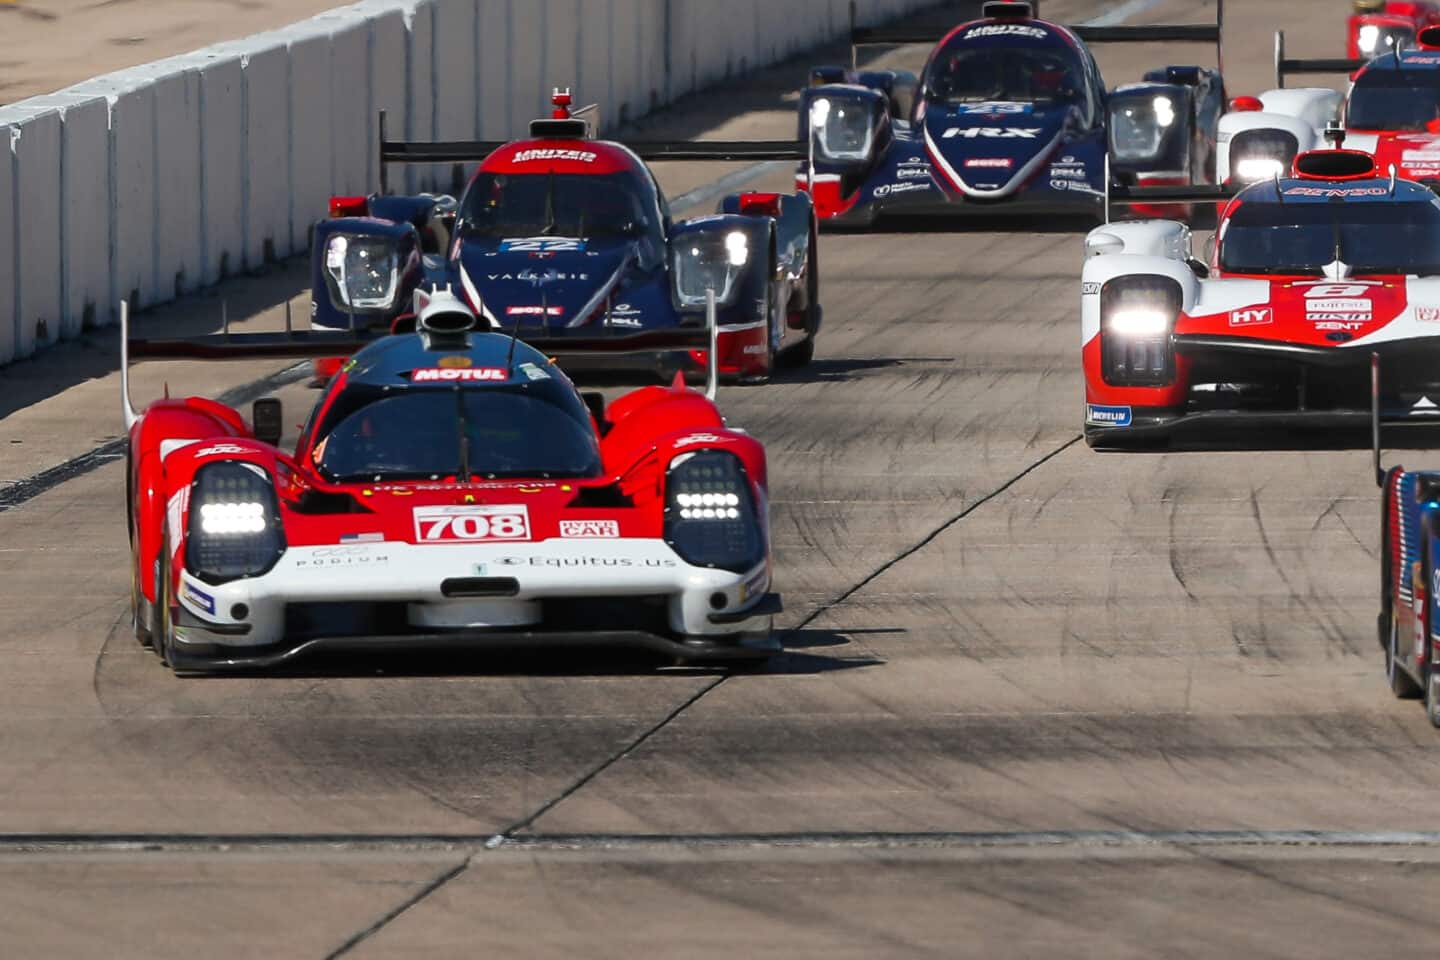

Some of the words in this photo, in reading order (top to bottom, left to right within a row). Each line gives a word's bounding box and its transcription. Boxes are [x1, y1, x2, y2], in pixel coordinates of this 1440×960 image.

[942, 127, 1042, 138] HRX
[1284, 186, 1387, 197] DENSO
[508, 240, 580, 251] 22
[1232, 309, 1269, 323] HY
[1314, 321, 1364, 330] ZENT
[413, 368, 505, 381] MOTUL
[419, 515, 525, 538] 708
[564, 527, 615, 536] CAR
[529, 555, 677, 568] Equitus.us
